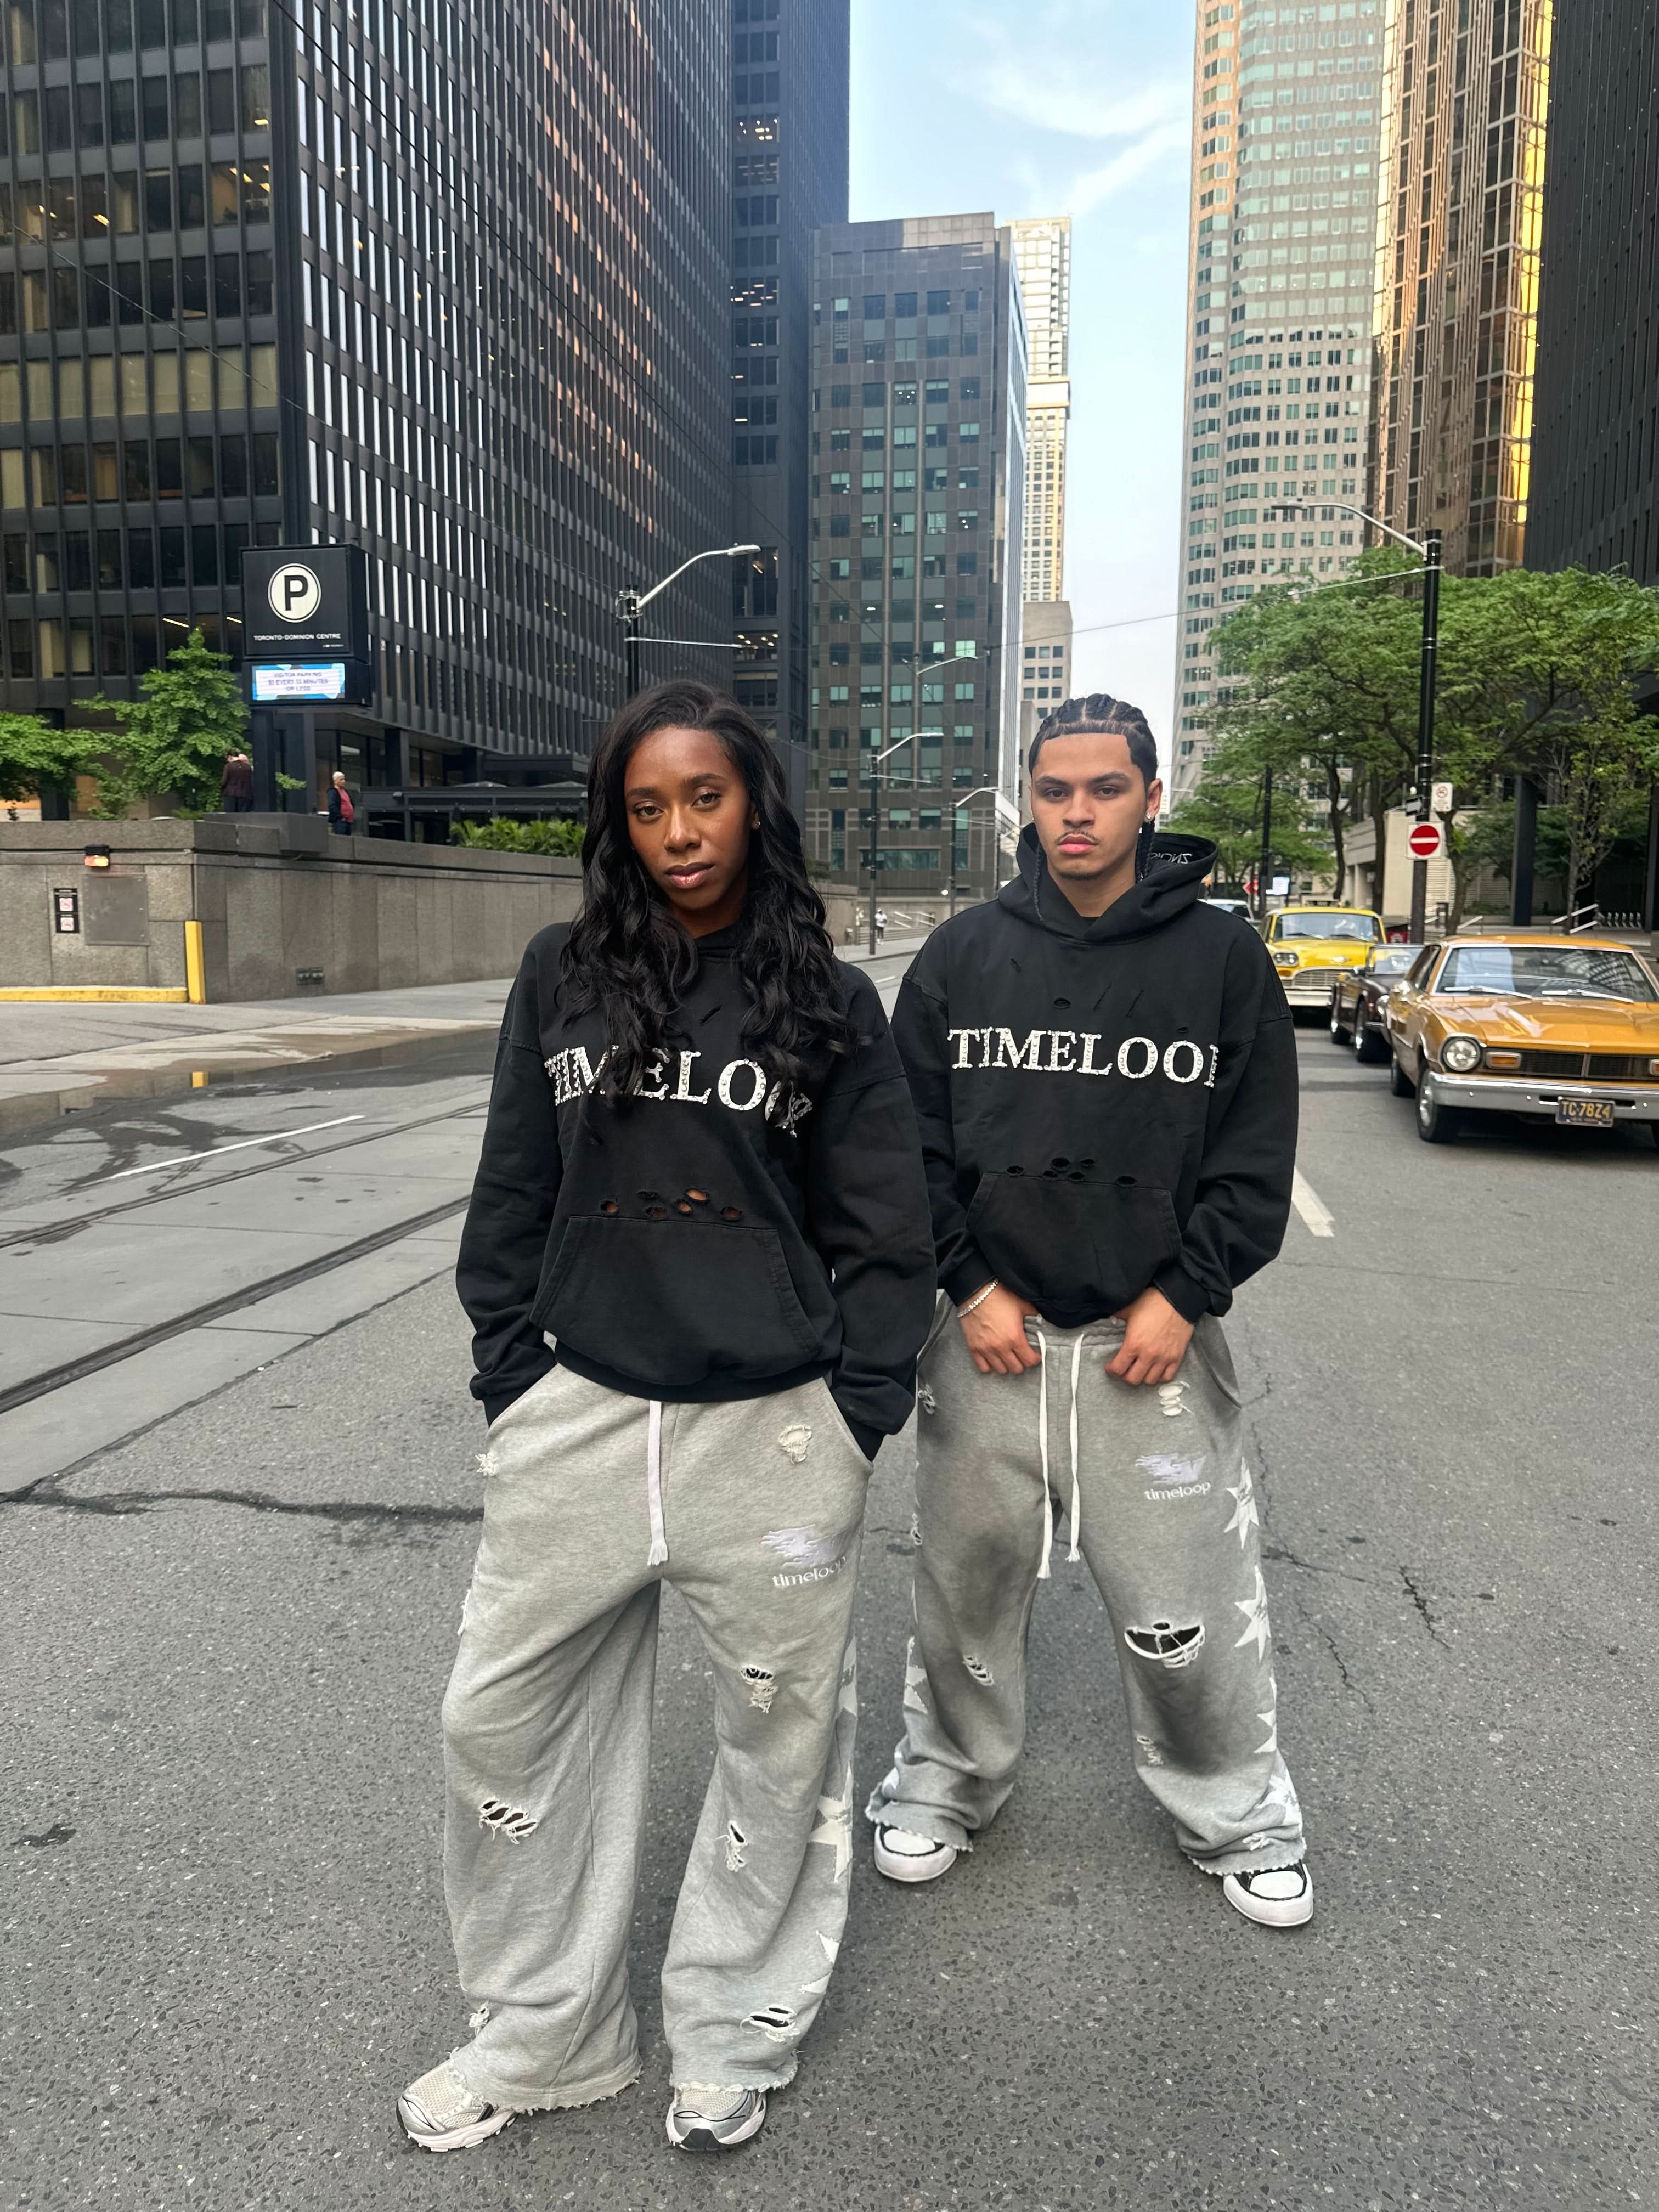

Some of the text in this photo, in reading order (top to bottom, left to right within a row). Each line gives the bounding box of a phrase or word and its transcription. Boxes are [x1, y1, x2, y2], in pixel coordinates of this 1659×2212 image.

[284, 575, 308, 611] P
[947, 1026, 1220, 1088] TIMELOO
[1144, 1482, 1211, 1500] timeloop
